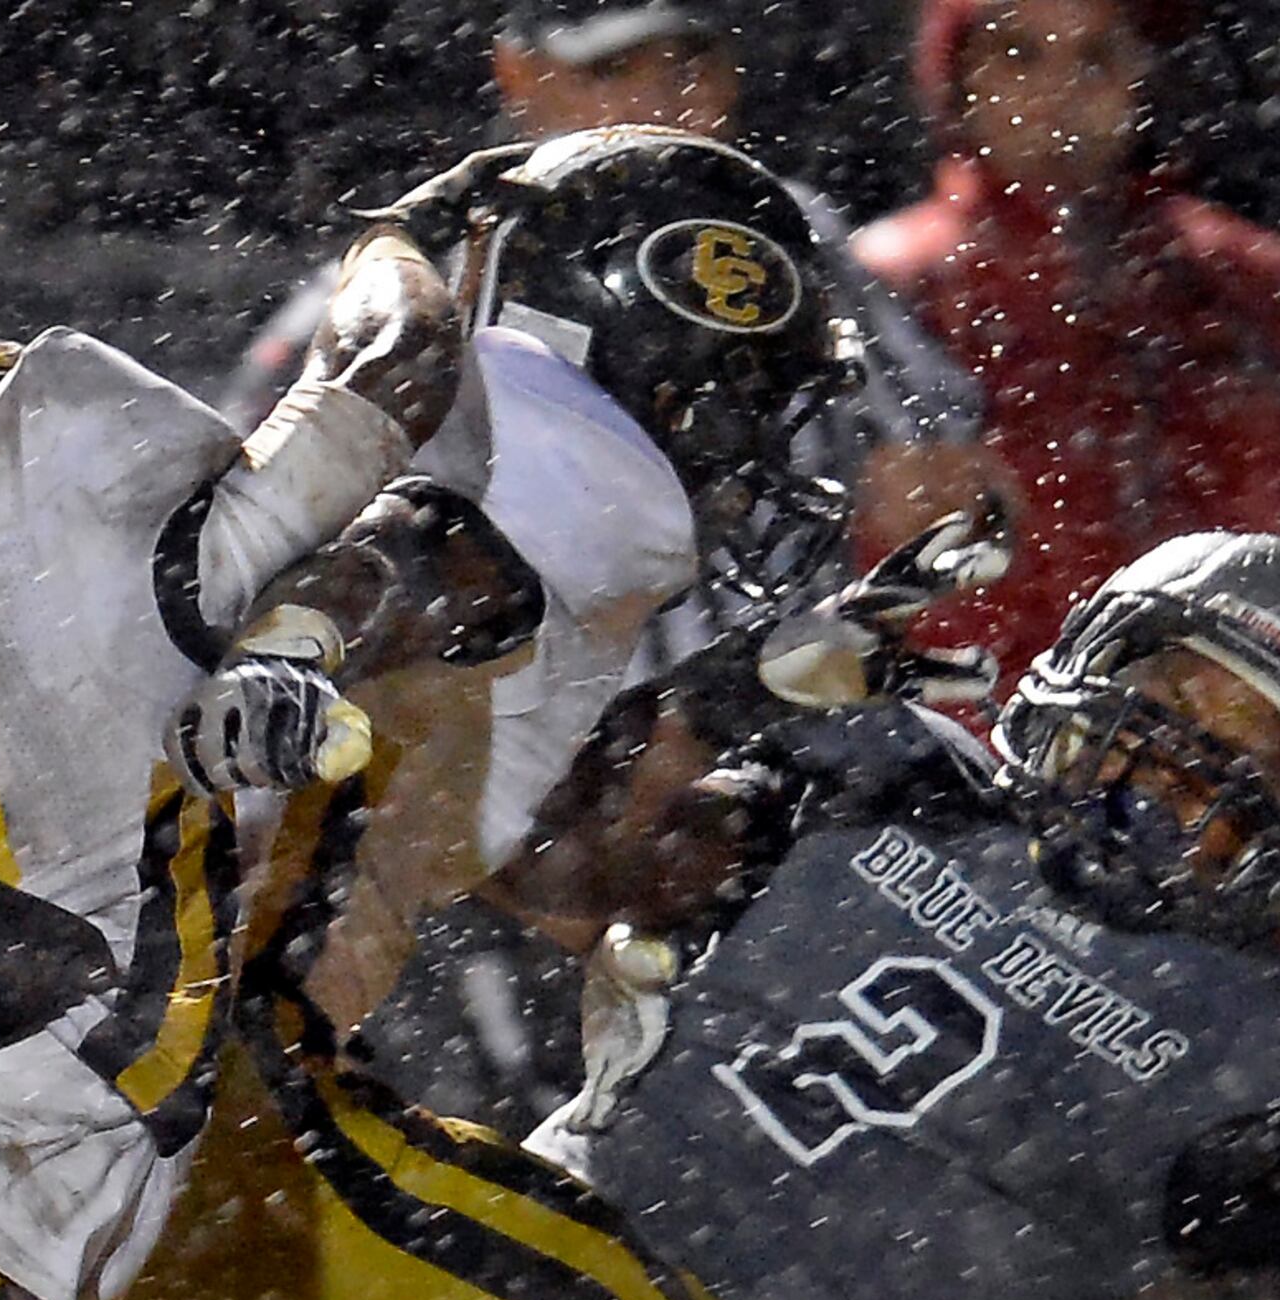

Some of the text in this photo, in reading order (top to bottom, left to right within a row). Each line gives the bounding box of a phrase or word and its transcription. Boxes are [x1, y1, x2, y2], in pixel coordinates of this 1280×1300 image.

[711, 955, 1004, 1168] 2
[848, 824, 1000, 953] BLUE
[980, 932, 1191, 1083] DEVILS
